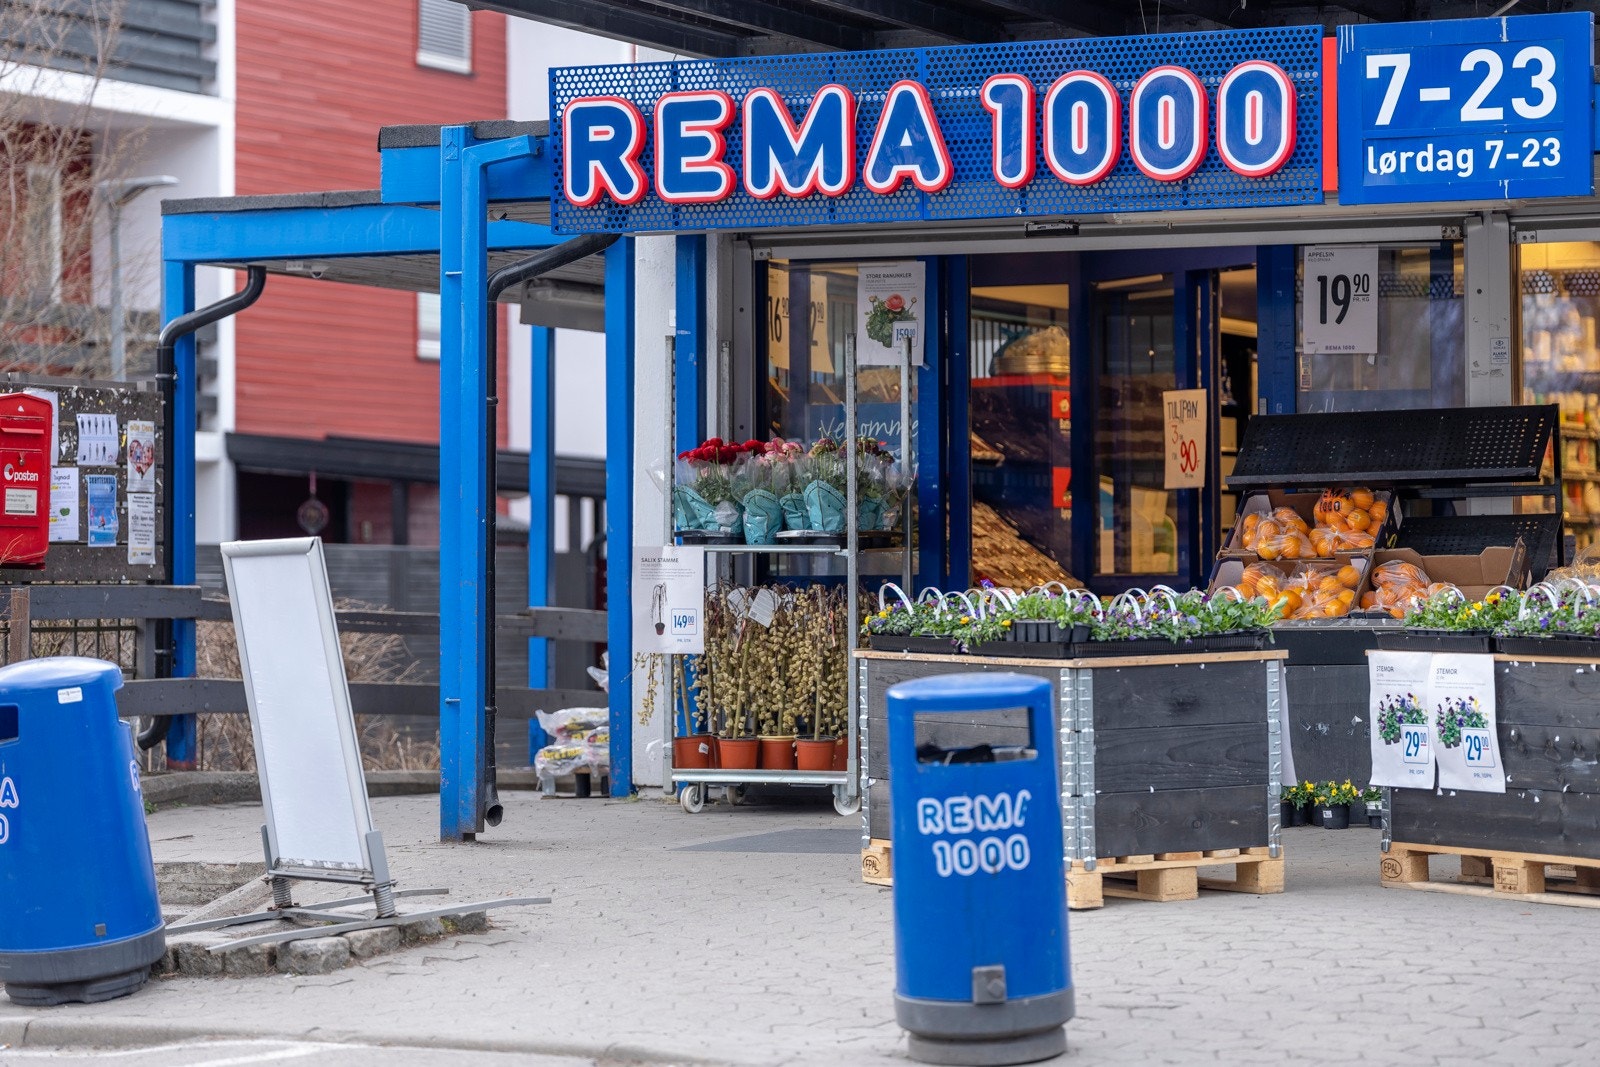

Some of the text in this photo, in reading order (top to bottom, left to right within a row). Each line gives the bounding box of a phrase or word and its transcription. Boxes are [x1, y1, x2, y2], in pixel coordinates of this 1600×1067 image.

[563, 60, 1297, 207] REMA 1000
[1367, 137, 1561, 178] lørdag 7-23
[1171, 425, 1179, 444] 3
[13, 470, 39, 482] posten
[674, 615, 687, 628] 149
[1376, 665, 1395, 673] STEMOR
[1405, 731, 1420, 757] 29
[1465, 734, 1482, 760] 29
[932, 834, 1031, 878] 1000
[1383, 862, 1398, 875] EPAL
